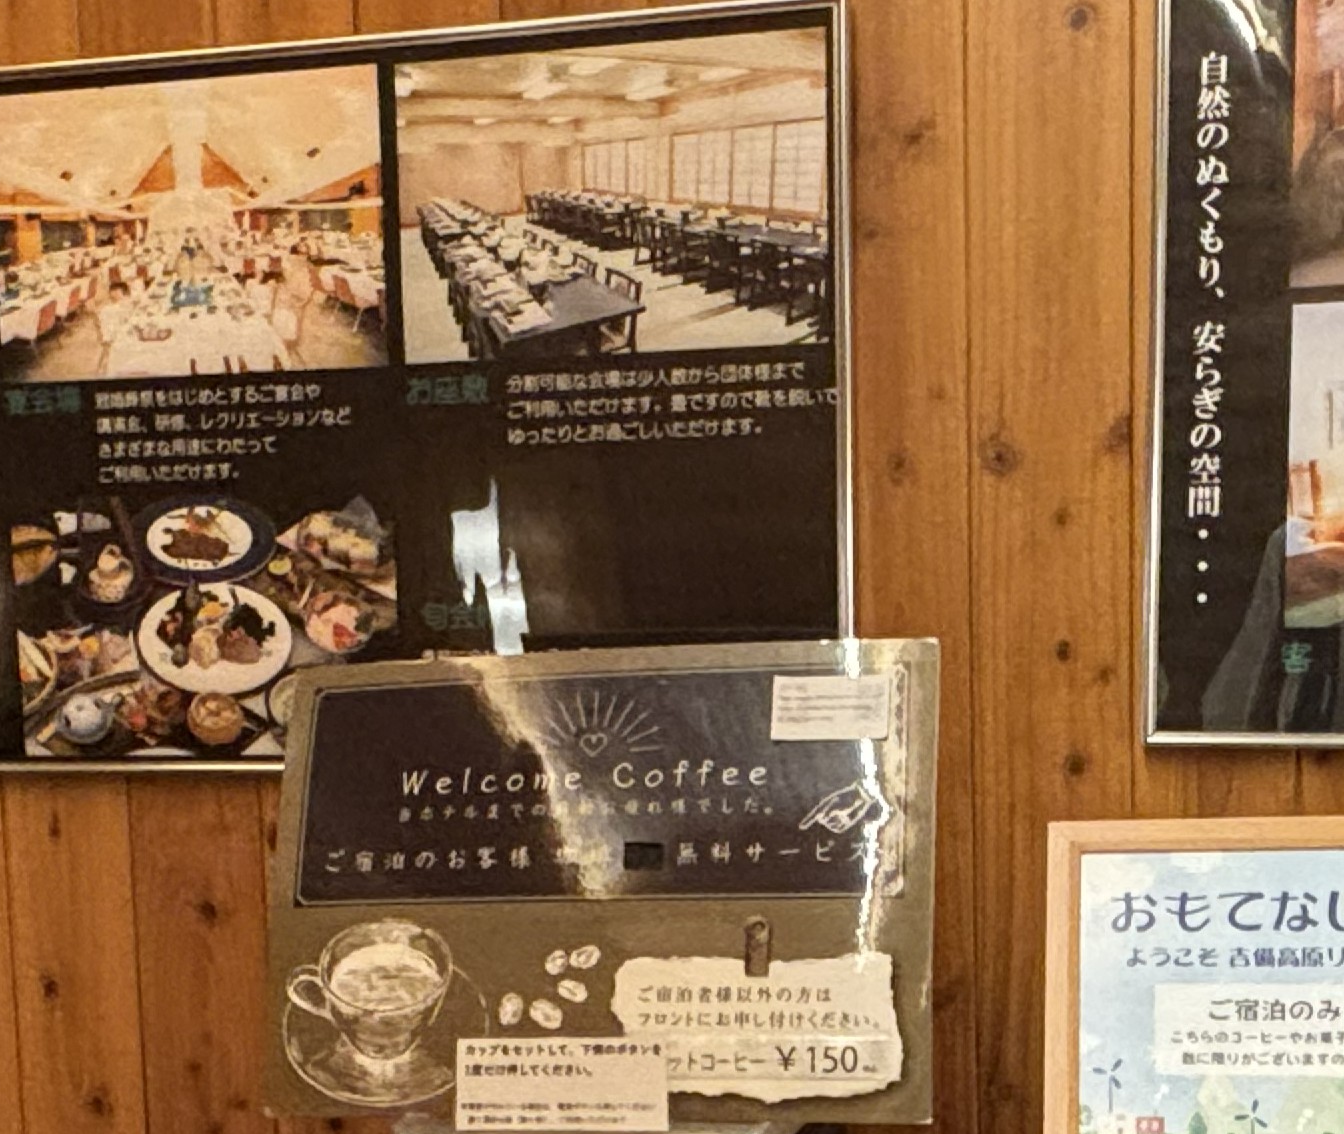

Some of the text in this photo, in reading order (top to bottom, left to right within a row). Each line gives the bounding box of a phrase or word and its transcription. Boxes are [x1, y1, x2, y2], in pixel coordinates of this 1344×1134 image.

[402, 760, 769, 797] Welcome Coffee
[1126, 947, 1218, 968] ようこそ
[638, 986, 832, 1004] ご宿泊者様以外の方は
